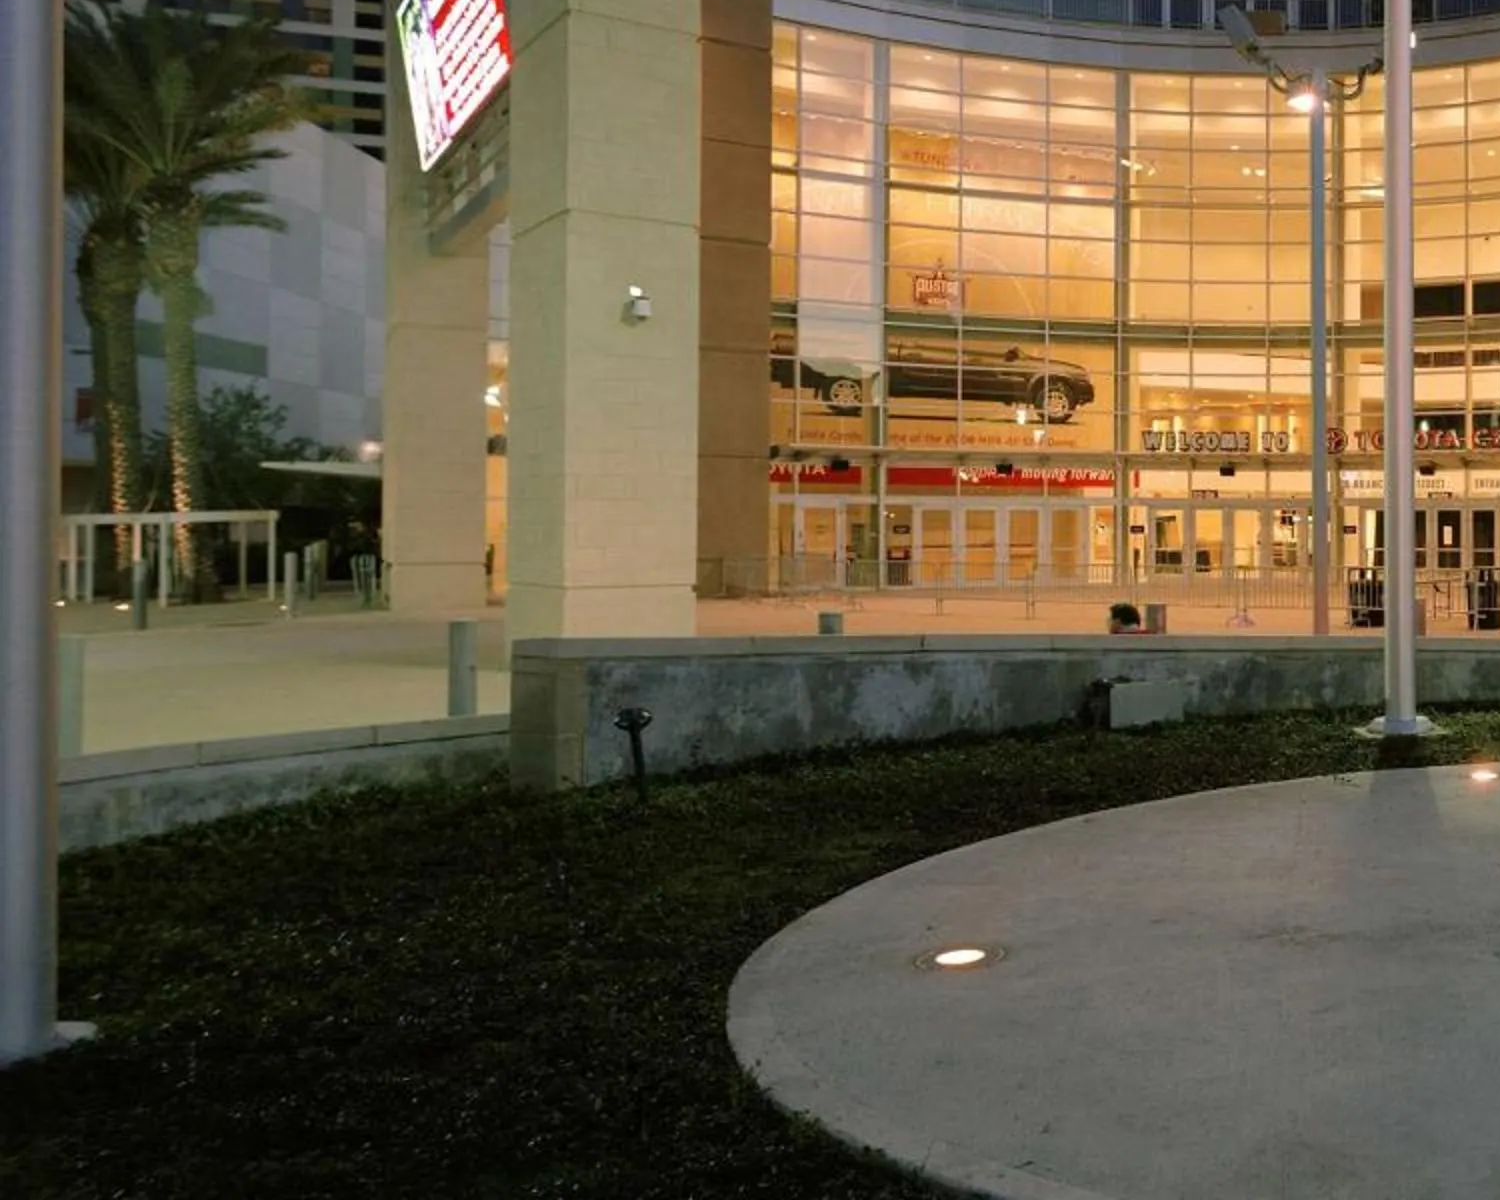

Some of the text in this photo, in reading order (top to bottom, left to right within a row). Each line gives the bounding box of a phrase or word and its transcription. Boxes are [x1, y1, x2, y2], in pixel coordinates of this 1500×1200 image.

[1142, 431, 1290, 452] WELCOME TO
[1354, 428, 1462, 451] TOOTA
[1071, 467, 1115, 481] forwar
